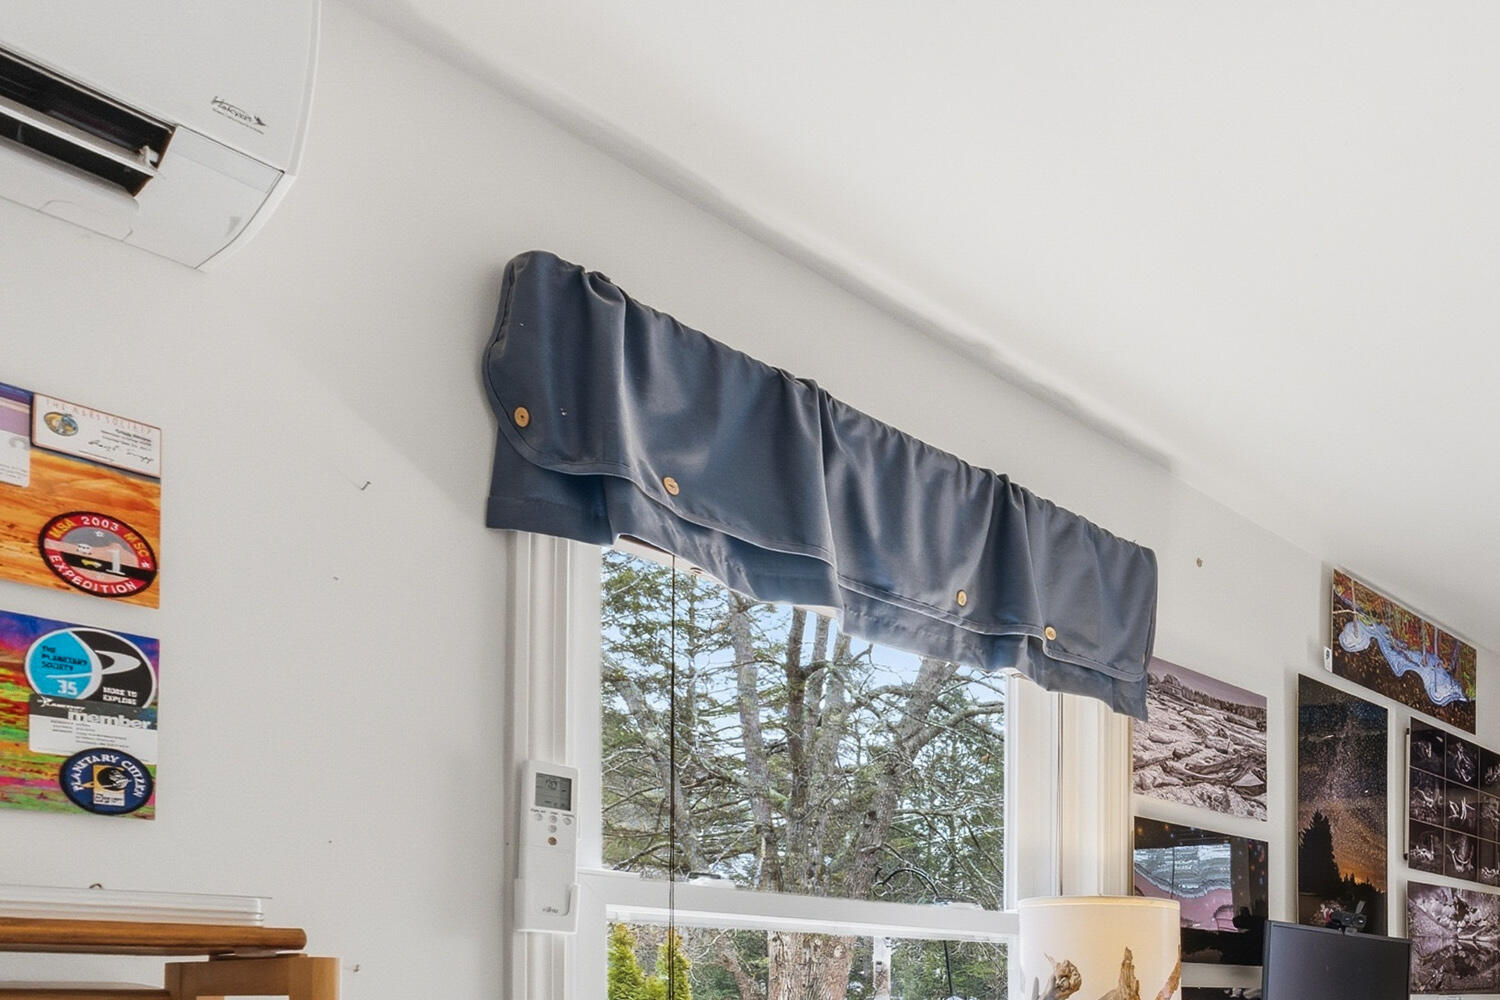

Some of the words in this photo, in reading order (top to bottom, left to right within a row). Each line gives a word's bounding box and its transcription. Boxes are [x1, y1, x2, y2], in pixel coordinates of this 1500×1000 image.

[81, 516, 119, 531] 2003
[49, 555, 137, 594] EXPEDITION
[42, 645, 56, 653] THE
[41, 653, 88, 666] PLANETARY
[41, 660, 73, 671] SOCIETY
[57, 679, 78, 696] 35
[68, 710, 151, 729] member
[70, 754, 120, 792] PLANETARY
[121, 760, 146, 797] CITIZEN
